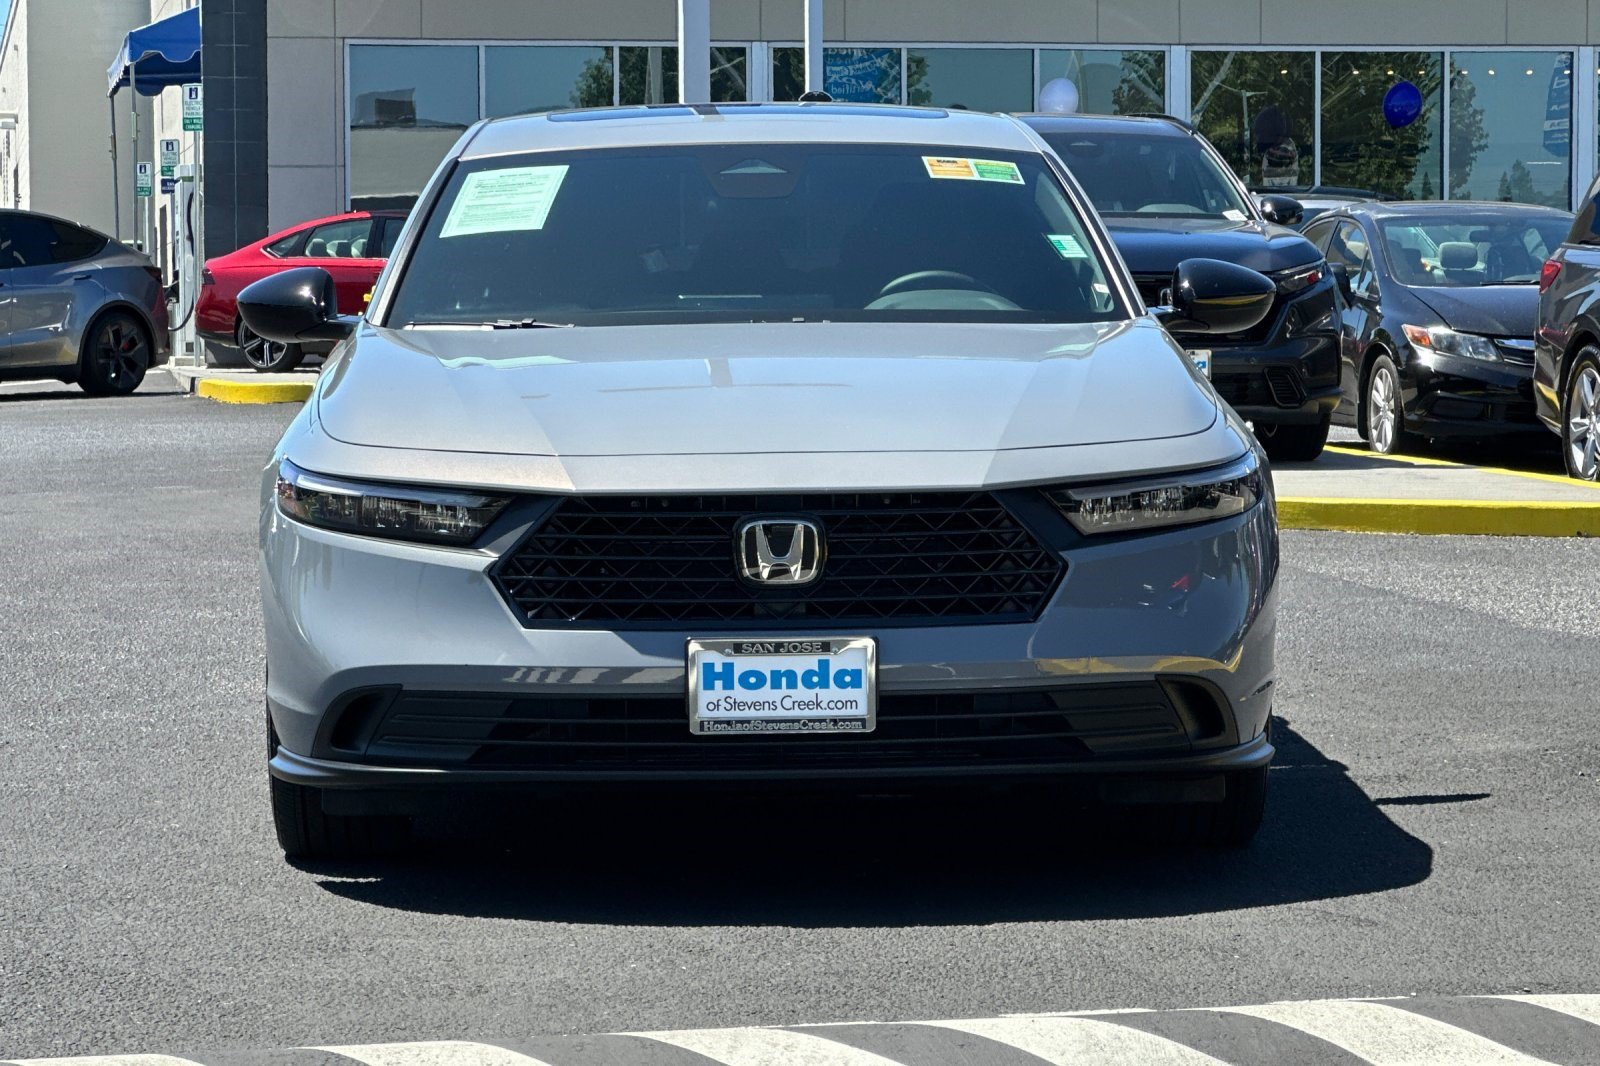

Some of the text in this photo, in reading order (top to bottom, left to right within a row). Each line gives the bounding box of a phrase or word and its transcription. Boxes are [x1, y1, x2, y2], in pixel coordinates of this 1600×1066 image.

[741, 642, 823, 653] SAN JOSE
[702, 659, 863, 691] Honda
[706, 693, 858, 712] of Stevens Creek.com
[703, 719, 863, 731] HondaofStevensCreek.com
